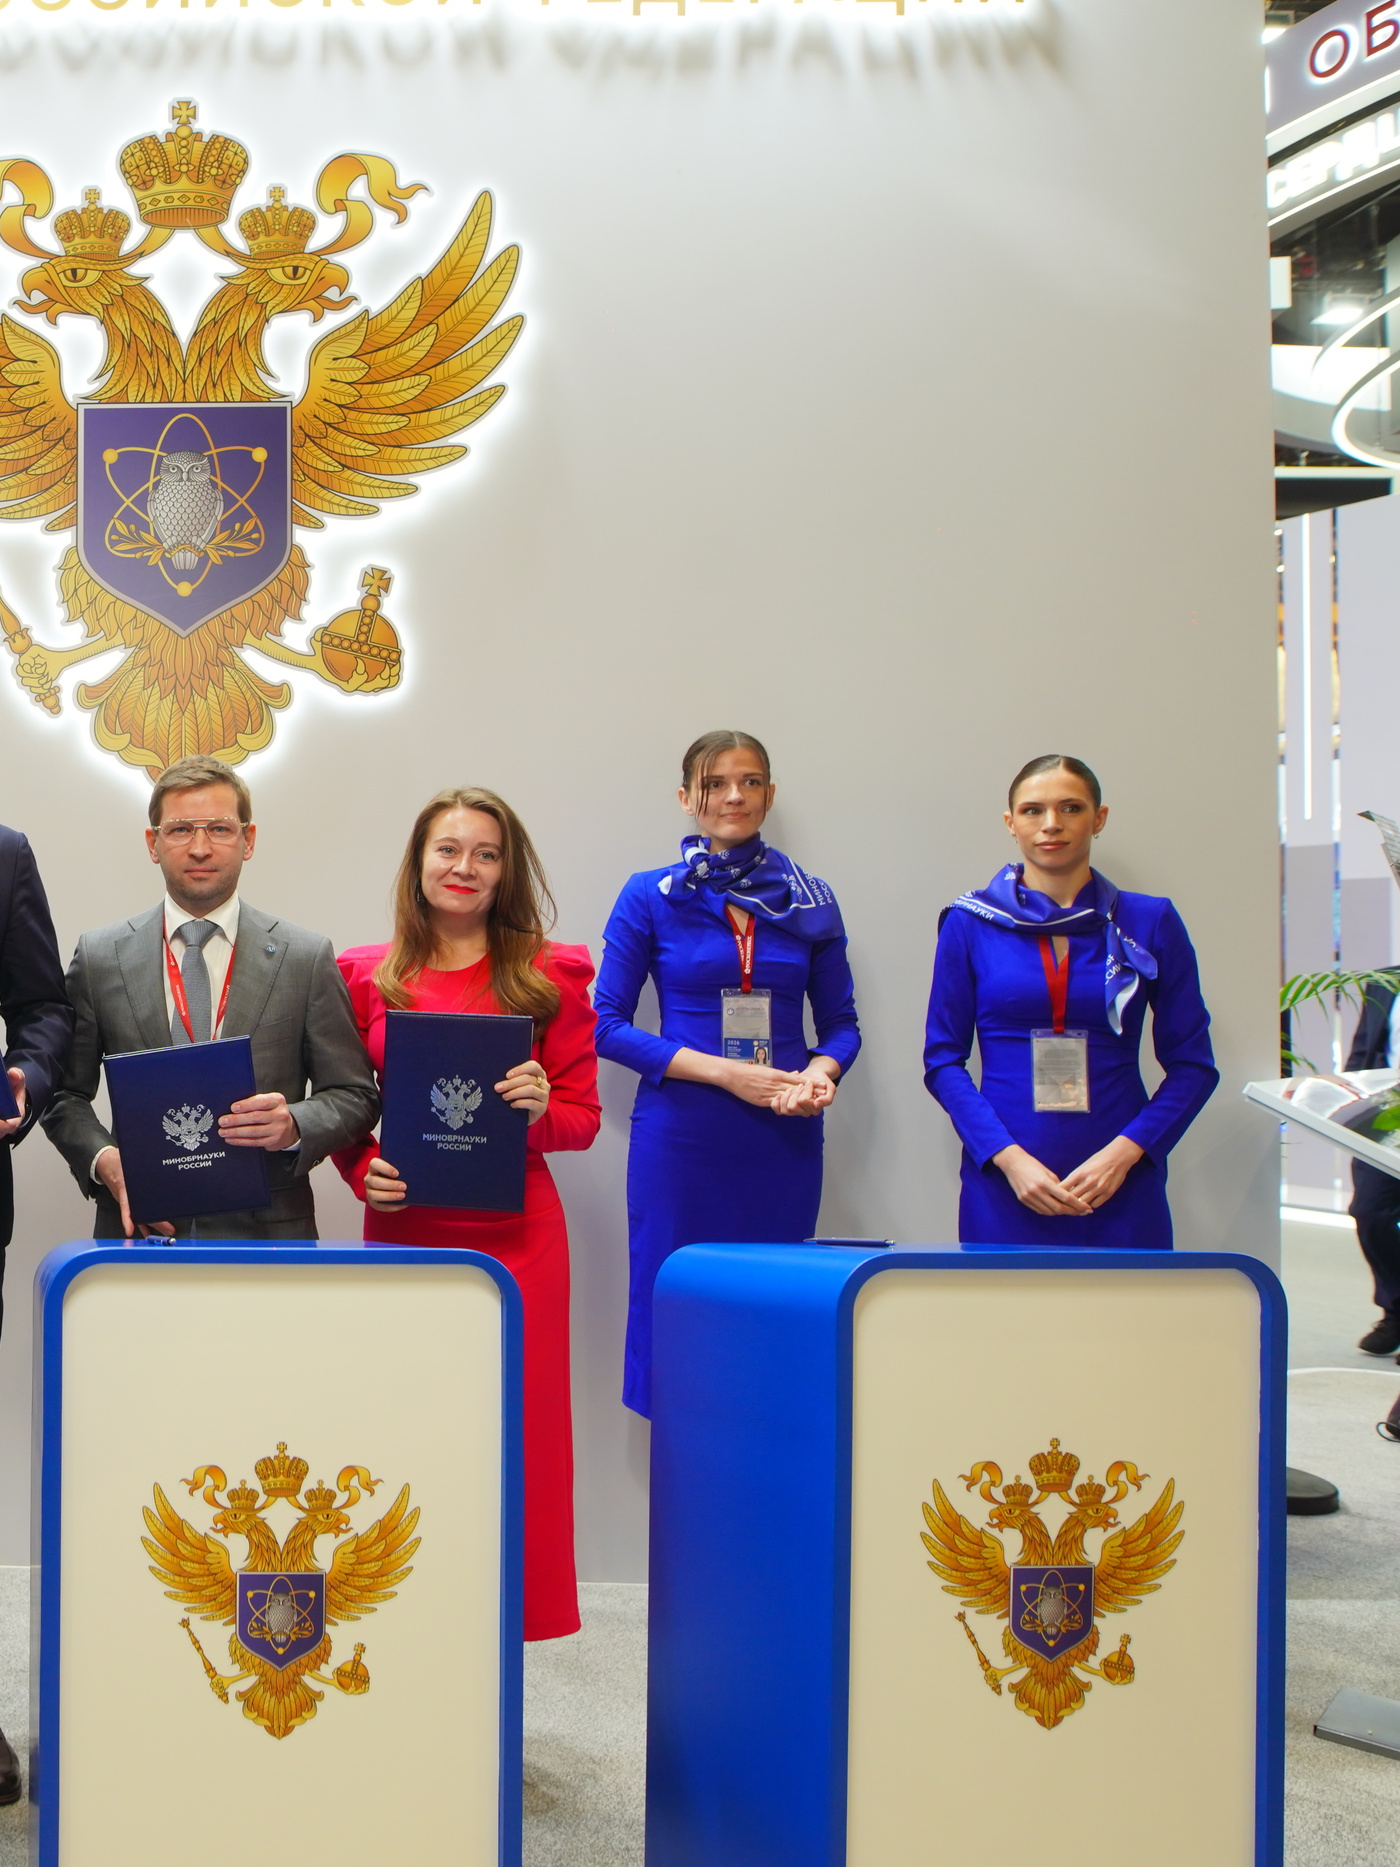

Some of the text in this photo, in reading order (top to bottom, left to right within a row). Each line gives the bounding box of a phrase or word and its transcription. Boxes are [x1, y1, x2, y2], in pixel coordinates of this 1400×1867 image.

[422, 1133, 487, 1144] МИНОБРНАУКИ
[437, 1143, 472, 1151] РОССИИ
[162, 1151, 226, 1166] МИНОБРНАУКИ
[178, 1160, 212, 1171] РОССИИ
